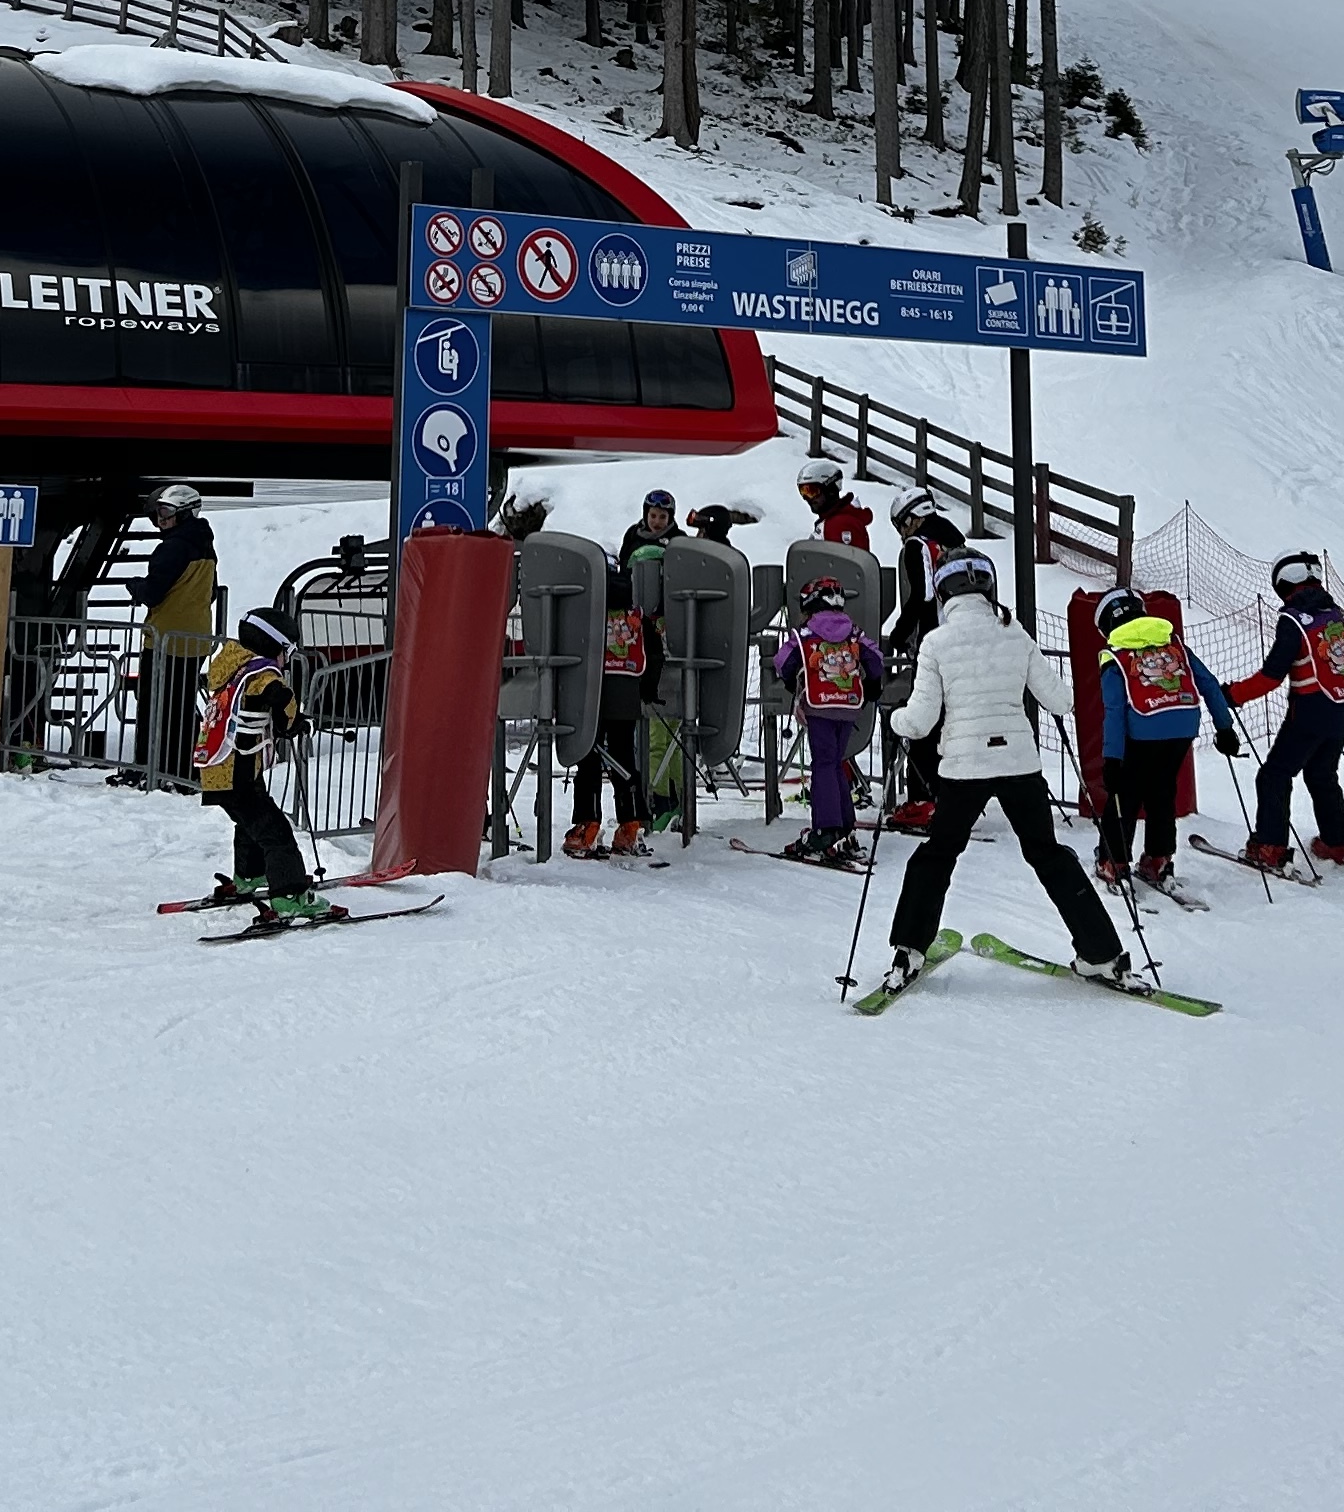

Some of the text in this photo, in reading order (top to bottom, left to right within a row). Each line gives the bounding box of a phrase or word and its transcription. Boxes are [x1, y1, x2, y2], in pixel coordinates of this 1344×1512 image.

[676, 242, 711, 255] PREZZI
[676, 255, 711, 268] PREISE
[668, 277, 690, 287] Corsa
[912, 269, 941, 282] ORARI
[890, 279, 964, 296] BETRIEBSZEITEN
[0, 272, 218, 319] LEITNER
[732, 291, 879, 326] WASTENEGG
[900, 306, 921, 318] 8:45
[929, 309, 954, 321] 16:15
[988, 309, 1018, 320] SKIPASS
[65, 316, 220, 335] ropeways
[985, 319, 1021, 330] CONTROL
[445, 482, 459, 496] 18
